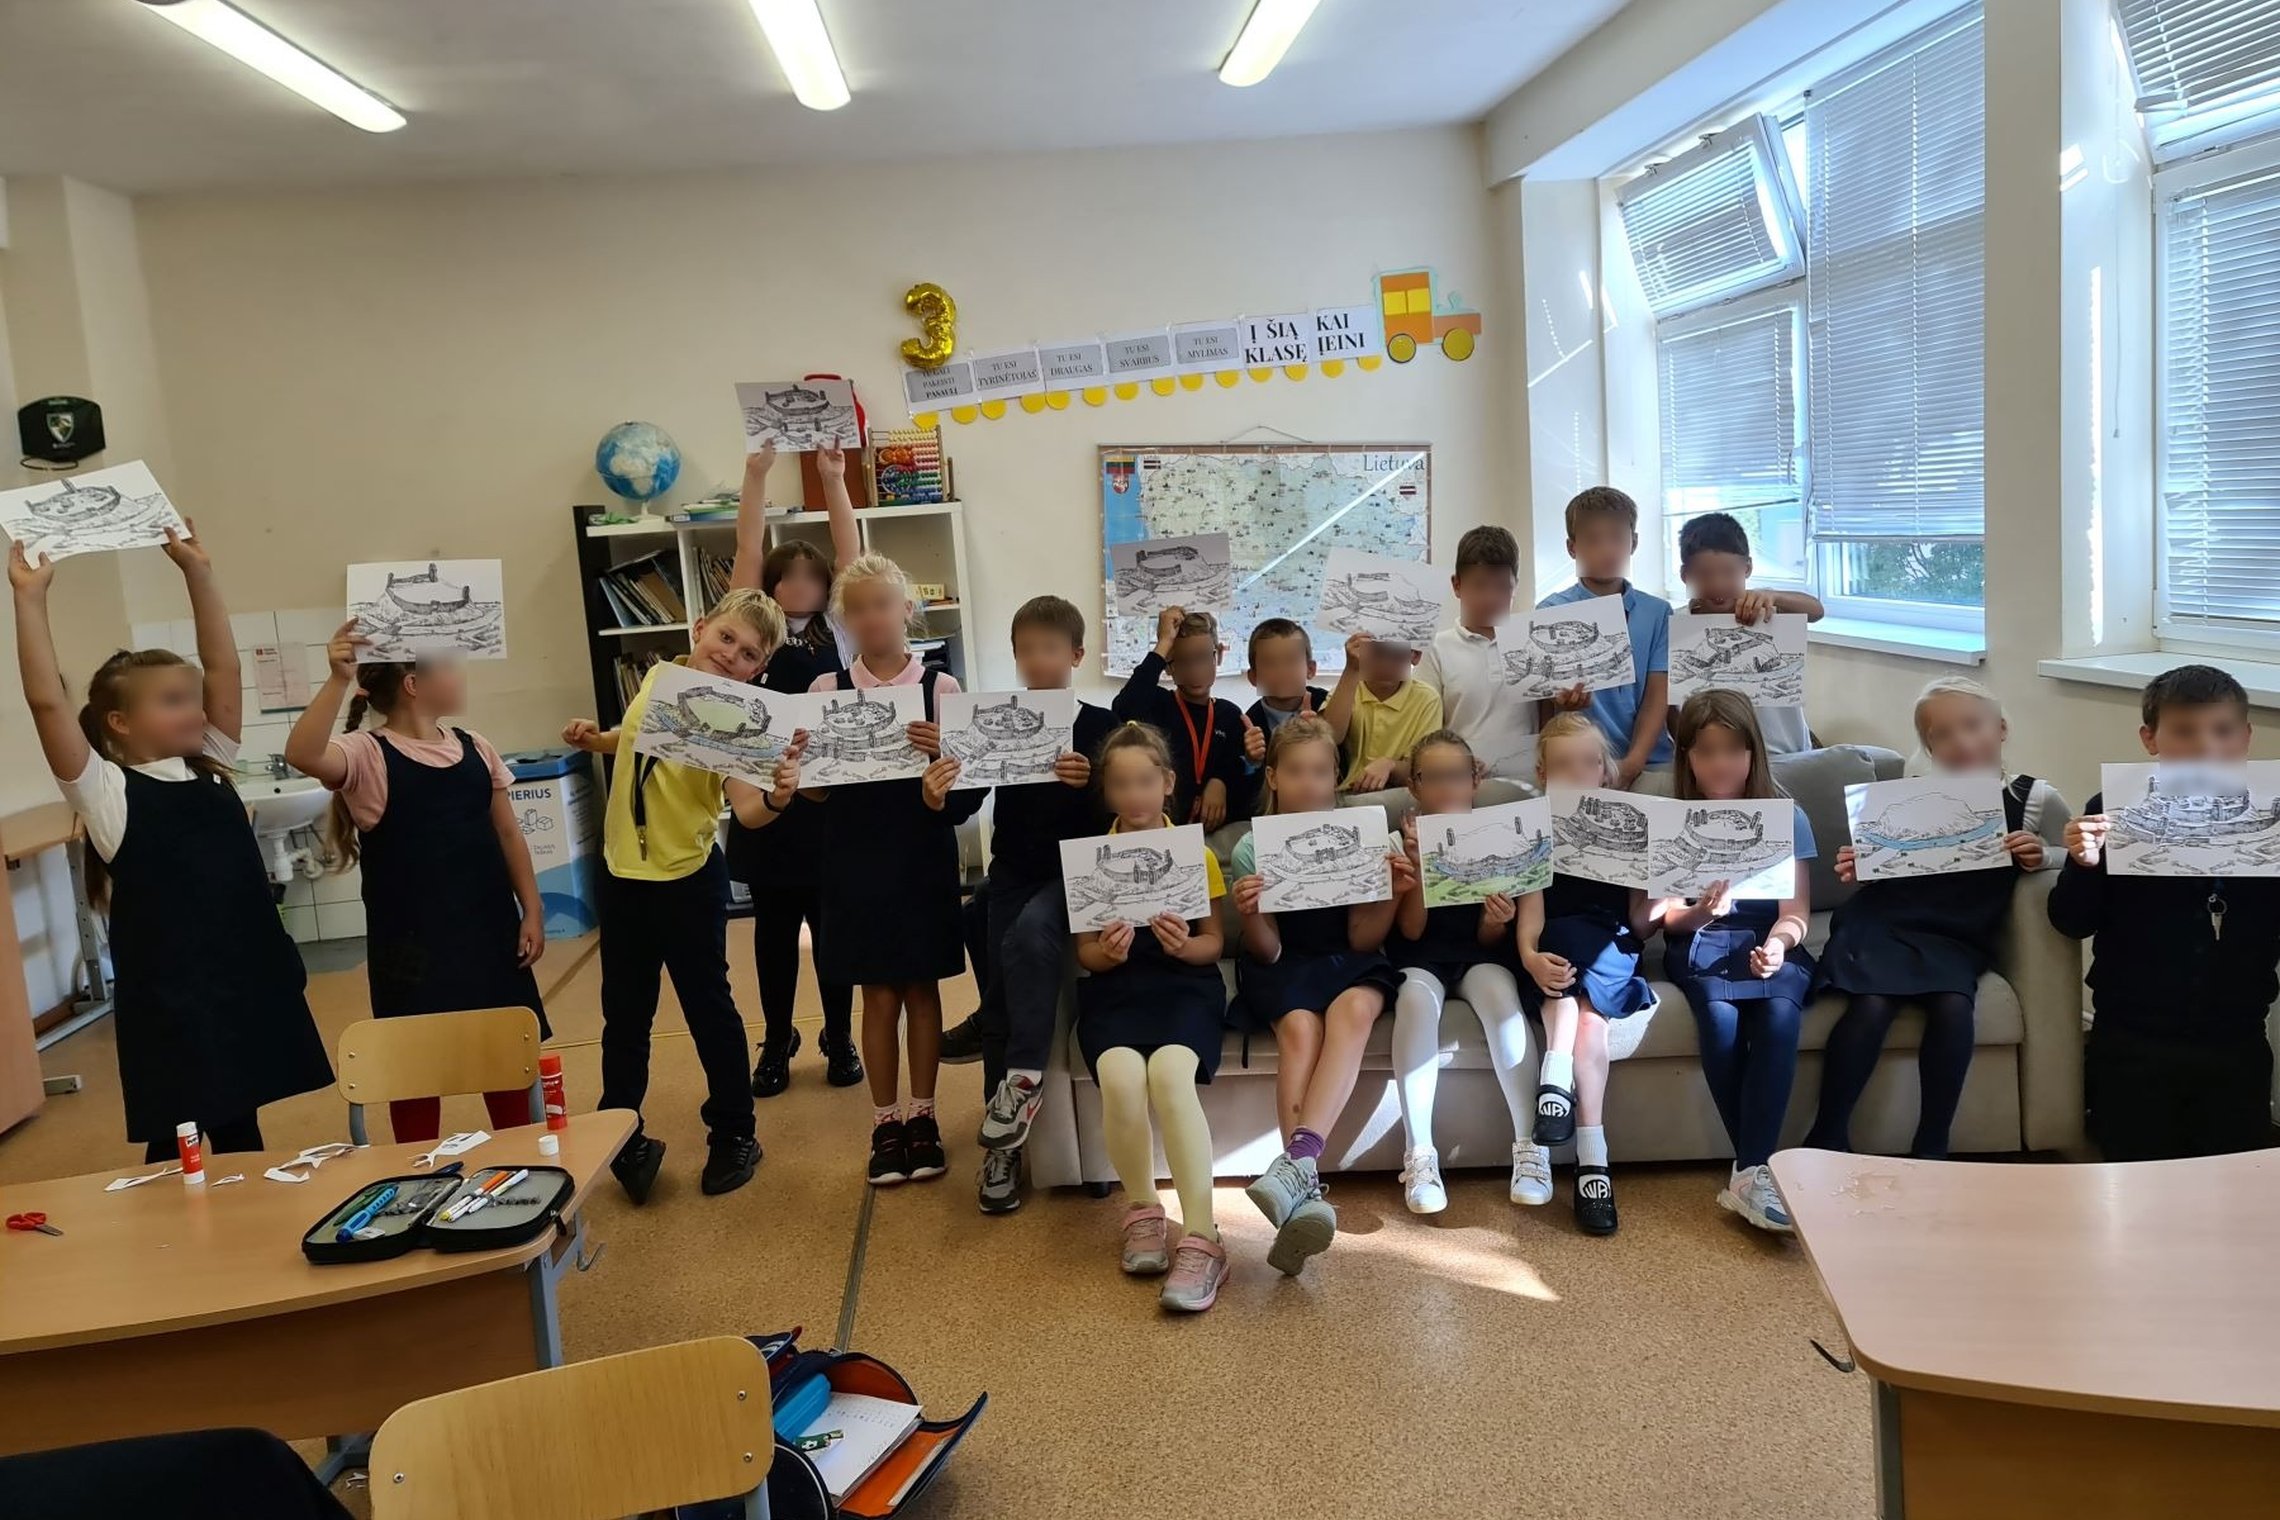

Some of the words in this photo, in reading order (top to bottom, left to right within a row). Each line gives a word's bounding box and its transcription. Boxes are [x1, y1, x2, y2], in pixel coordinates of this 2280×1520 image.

[901, 283, 956, 369] 3
[1316, 313, 1349, 331] KAI
[1250, 324, 1257, 344] Į
[1266, 318, 1299, 340] ŠIĄ
[1192, 337, 1203, 346] TU
[1205, 336, 1219, 344] ESI
[1318, 332, 1365, 356] ĮEINI
[1124, 346, 1134, 354] TU
[1187, 347, 1229, 358] MYLIMAS
[1245, 343, 1307, 363] KLASĘ
[1057, 354, 1066, 363] TU
[1119, 355, 1160, 368] SVARBUS
[992, 362, 1001, 371] TU
[1050, 365, 1093, 377] DRAUGAS
[979, 368, 1038, 386] TYRINĖTOJAS
[1363, 454, 1424, 472] Lietuva
[507, 788, 551, 800] IERIUS
